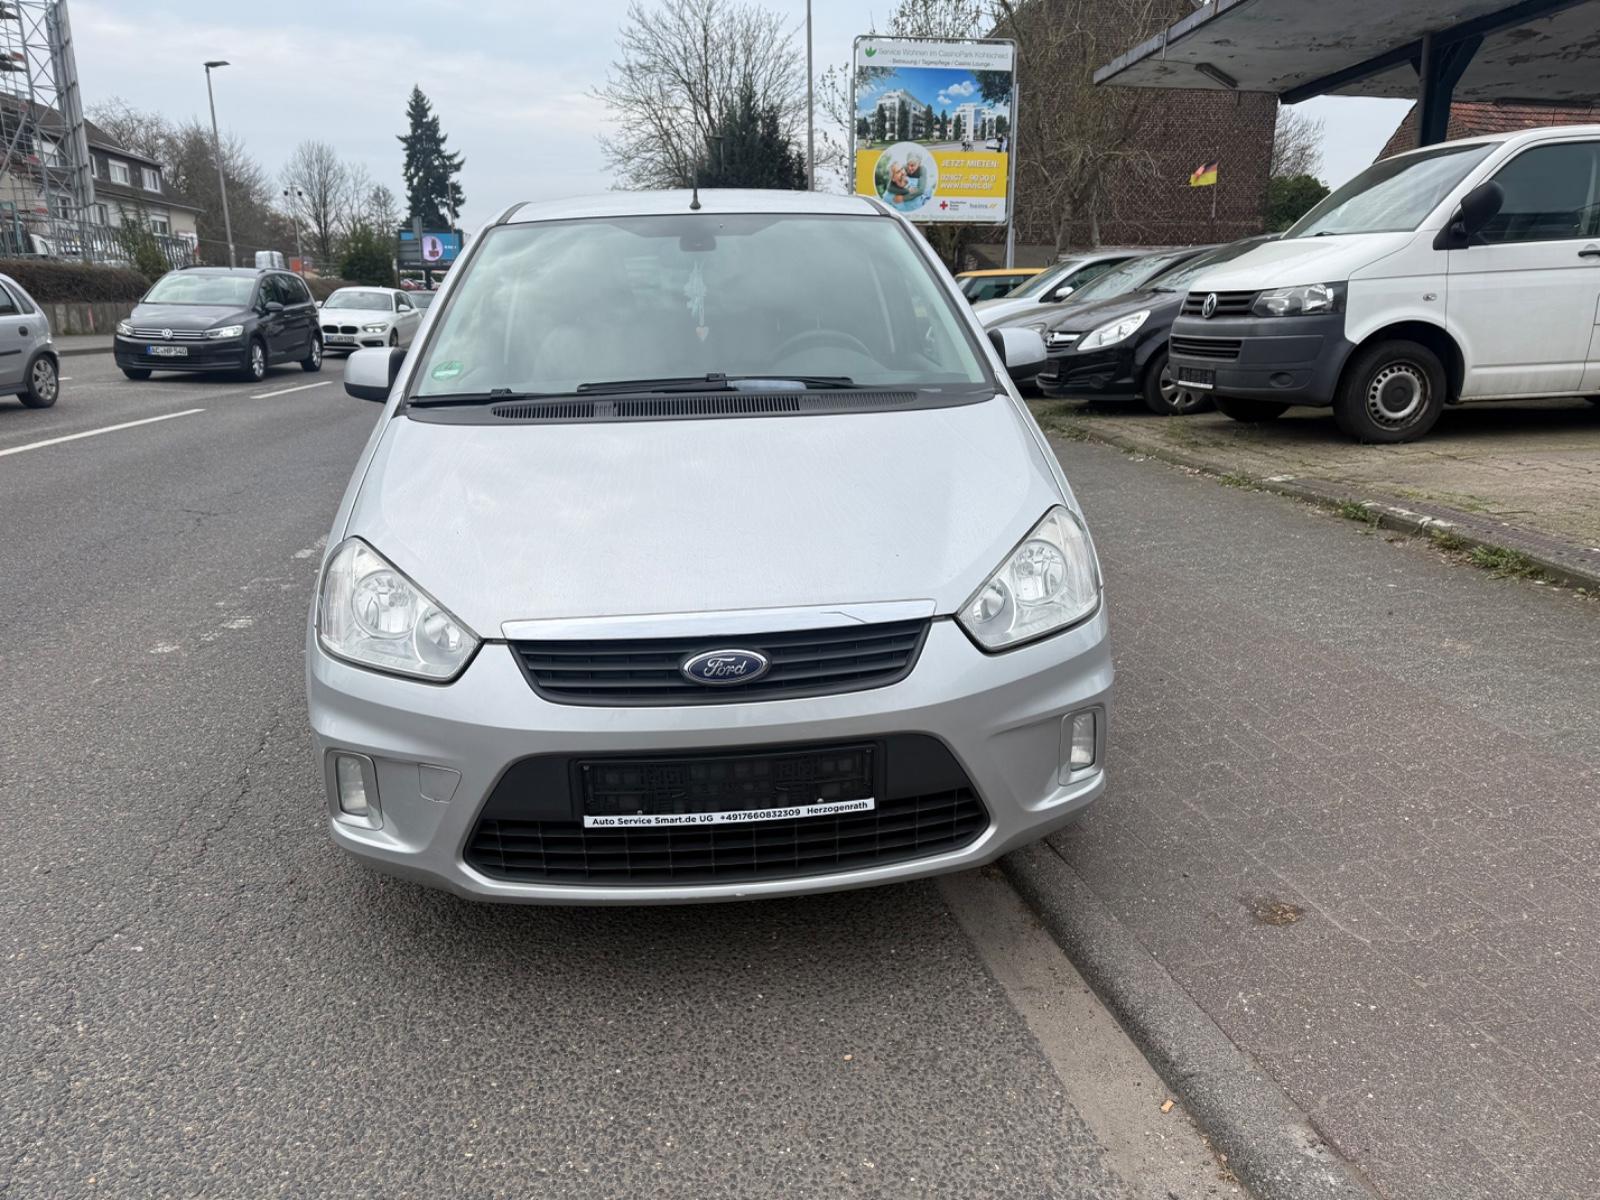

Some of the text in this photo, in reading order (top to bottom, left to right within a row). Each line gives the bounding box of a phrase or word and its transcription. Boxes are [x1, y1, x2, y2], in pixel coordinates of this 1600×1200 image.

[704, 657, 747, 676] Ford
[592, 800, 868, 826] Auto Service Smart.de UG +4917660832309 Herzogenrath
